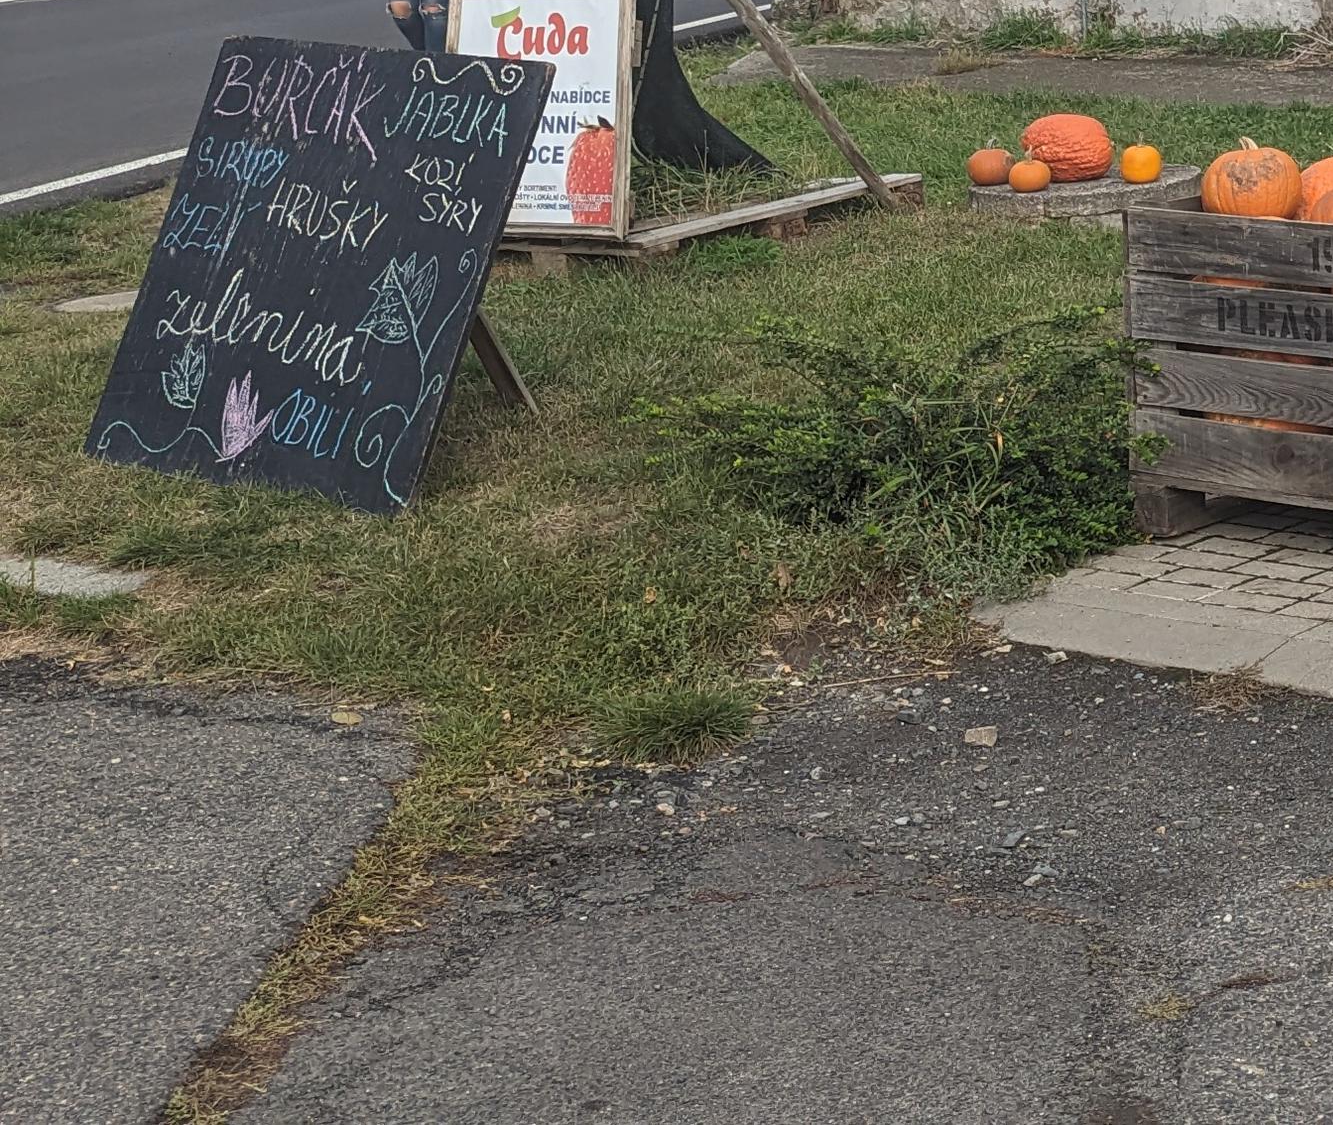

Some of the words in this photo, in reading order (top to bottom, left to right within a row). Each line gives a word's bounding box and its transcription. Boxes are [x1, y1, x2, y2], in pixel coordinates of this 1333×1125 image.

[213, 50, 385, 163] BURČÁK
[383, 84, 509, 158] JABLKA
[550, 86, 611, 104] NABÍDCE
[540, 110, 577, 134] NNÍ
[195, 135, 290, 189] SIRUPY
[404, 152, 475, 192] KOZÍ
[266, 177, 390, 253] HRUŠKY
[418, 186, 484, 237] SÝRY
